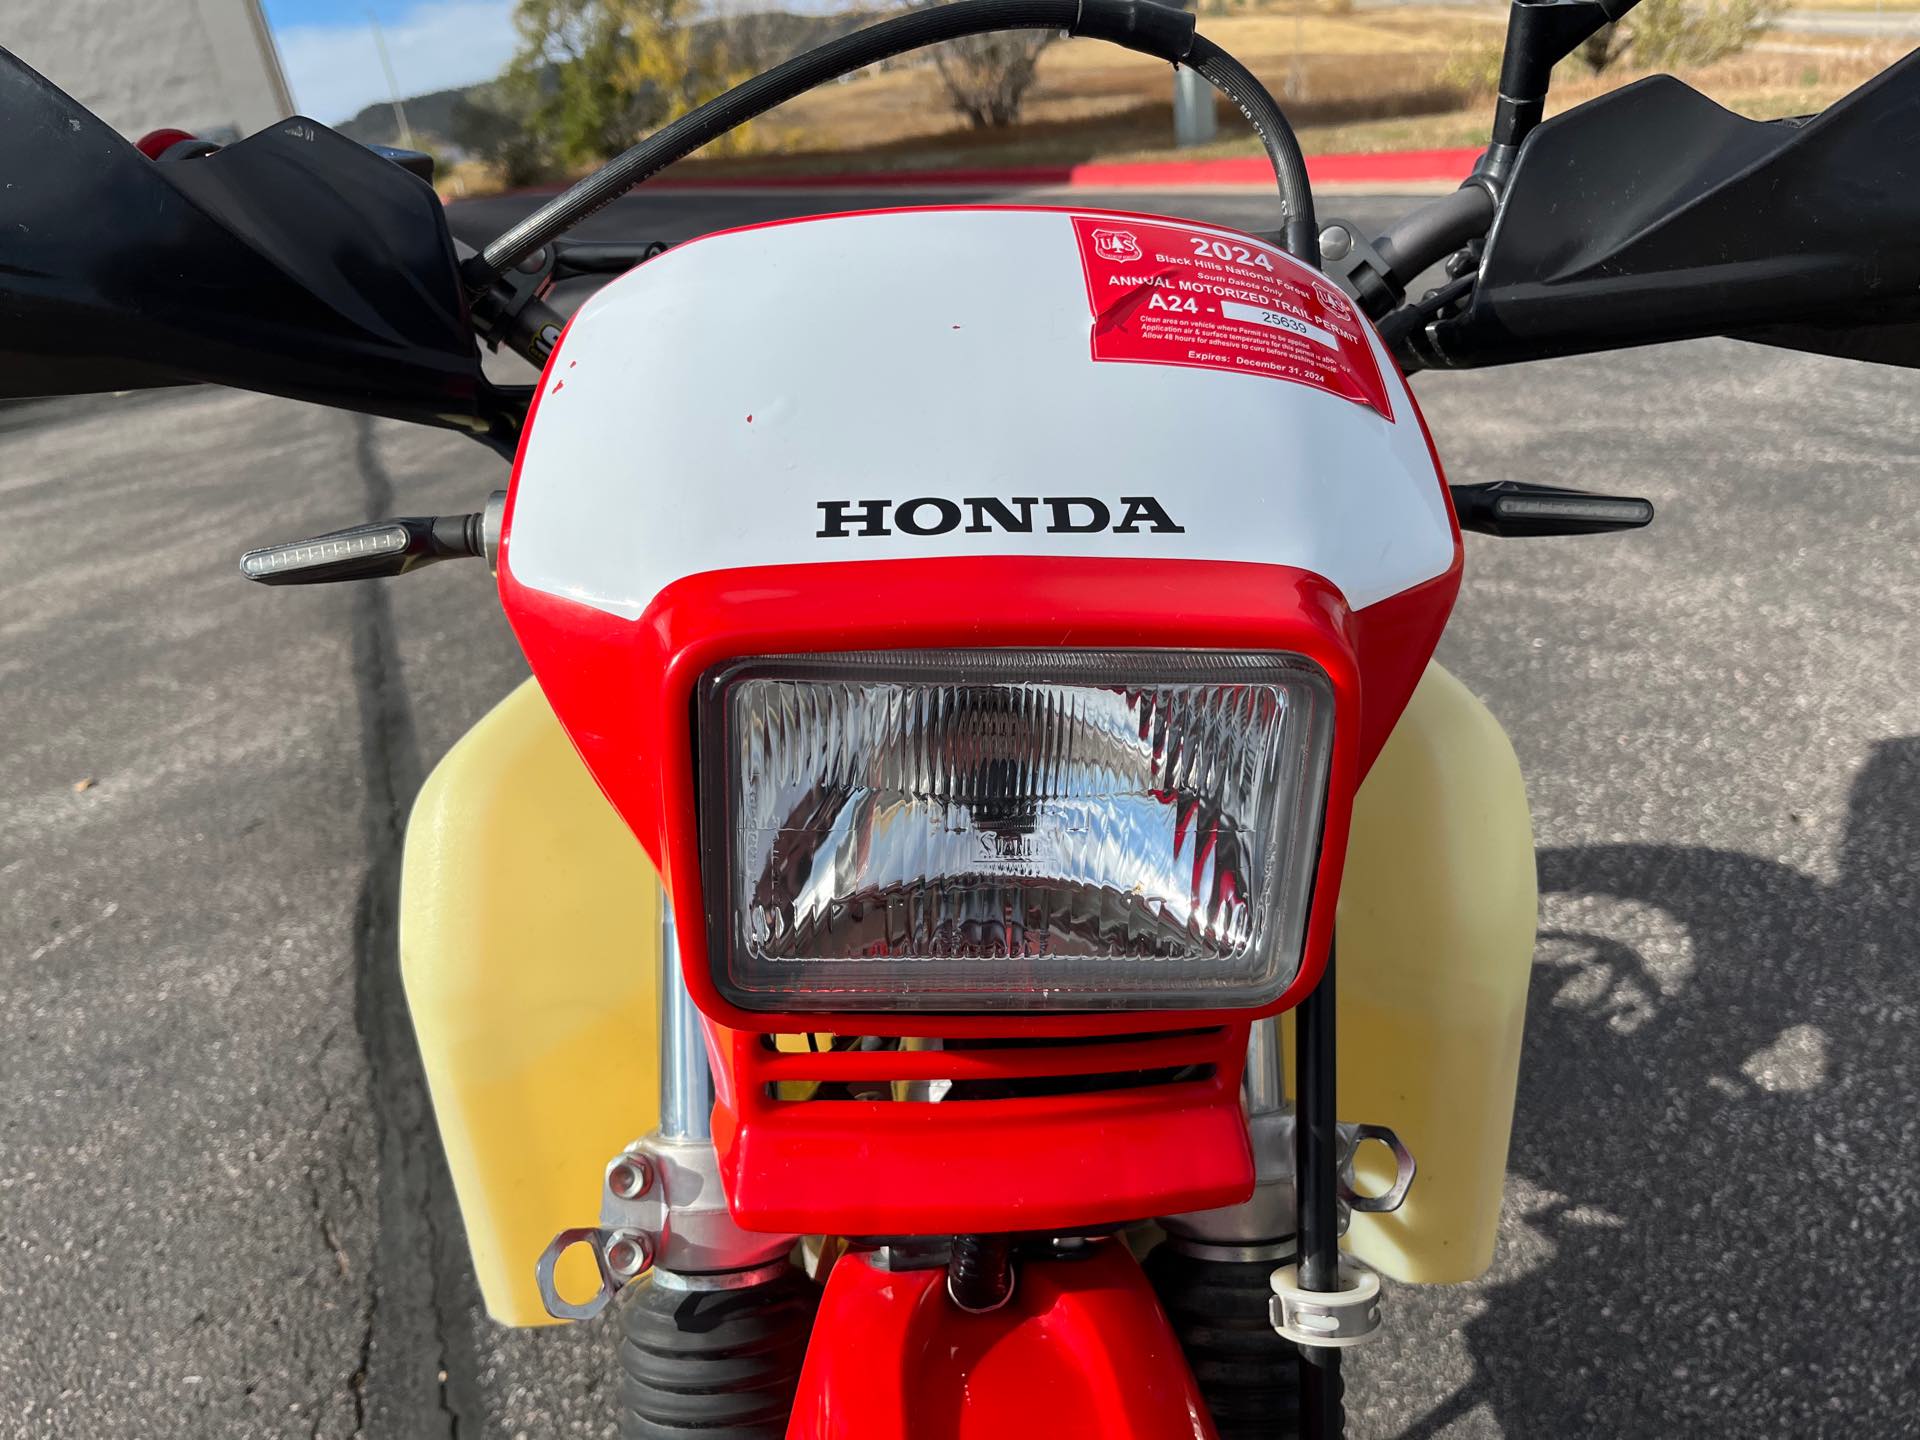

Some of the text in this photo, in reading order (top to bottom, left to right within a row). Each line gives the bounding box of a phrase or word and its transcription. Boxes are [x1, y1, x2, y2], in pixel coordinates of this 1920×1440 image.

[1190, 237, 1274, 272] 2024
[1155, 253, 1311, 300] Black Hills National Forest
[1197, 272, 1284, 298] South Dakota Only
[1108, 275, 1360, 344] ANNUAL MOTORIZED TRAIL PERMIT
[1148, 293, 1199, 314] A24
[1139, 315, 1161, 324] Clean
[1190, 320, 1216, 329] vehicle
[1216, 323, 1238, 332] where
[1238, 327, 1261, 337] Permit
[1278, 334, 1287, 342] be
[1141, 323, 1183, 333] Application
[1202, 329, 1228, 339] surface
[1229, 333, 1270, 346] temperature
[1271, 340, 1281, 348] for
[1281, 342, 1294, 351] this
[1261, 311, 1308, 334] 25639
[1142, 331, 1163, 339] Allow
[1164, 333, 1174, 341] 48
[1174, 335, 1196, 343] hours
[1197, 336, 1208, 344] for
[1209, 337, 1240, 348] adhesive
[1241, 342, 1249, 350] to
[1249, 345, 1265, 353] cure
[1266, 347, 1288, 357] before
[1289, 352, 1315, 366] washing
[1188, 350, 1325, 383] Expires: December 31, 2024
[815, 496, 1186, 539] HONDA
